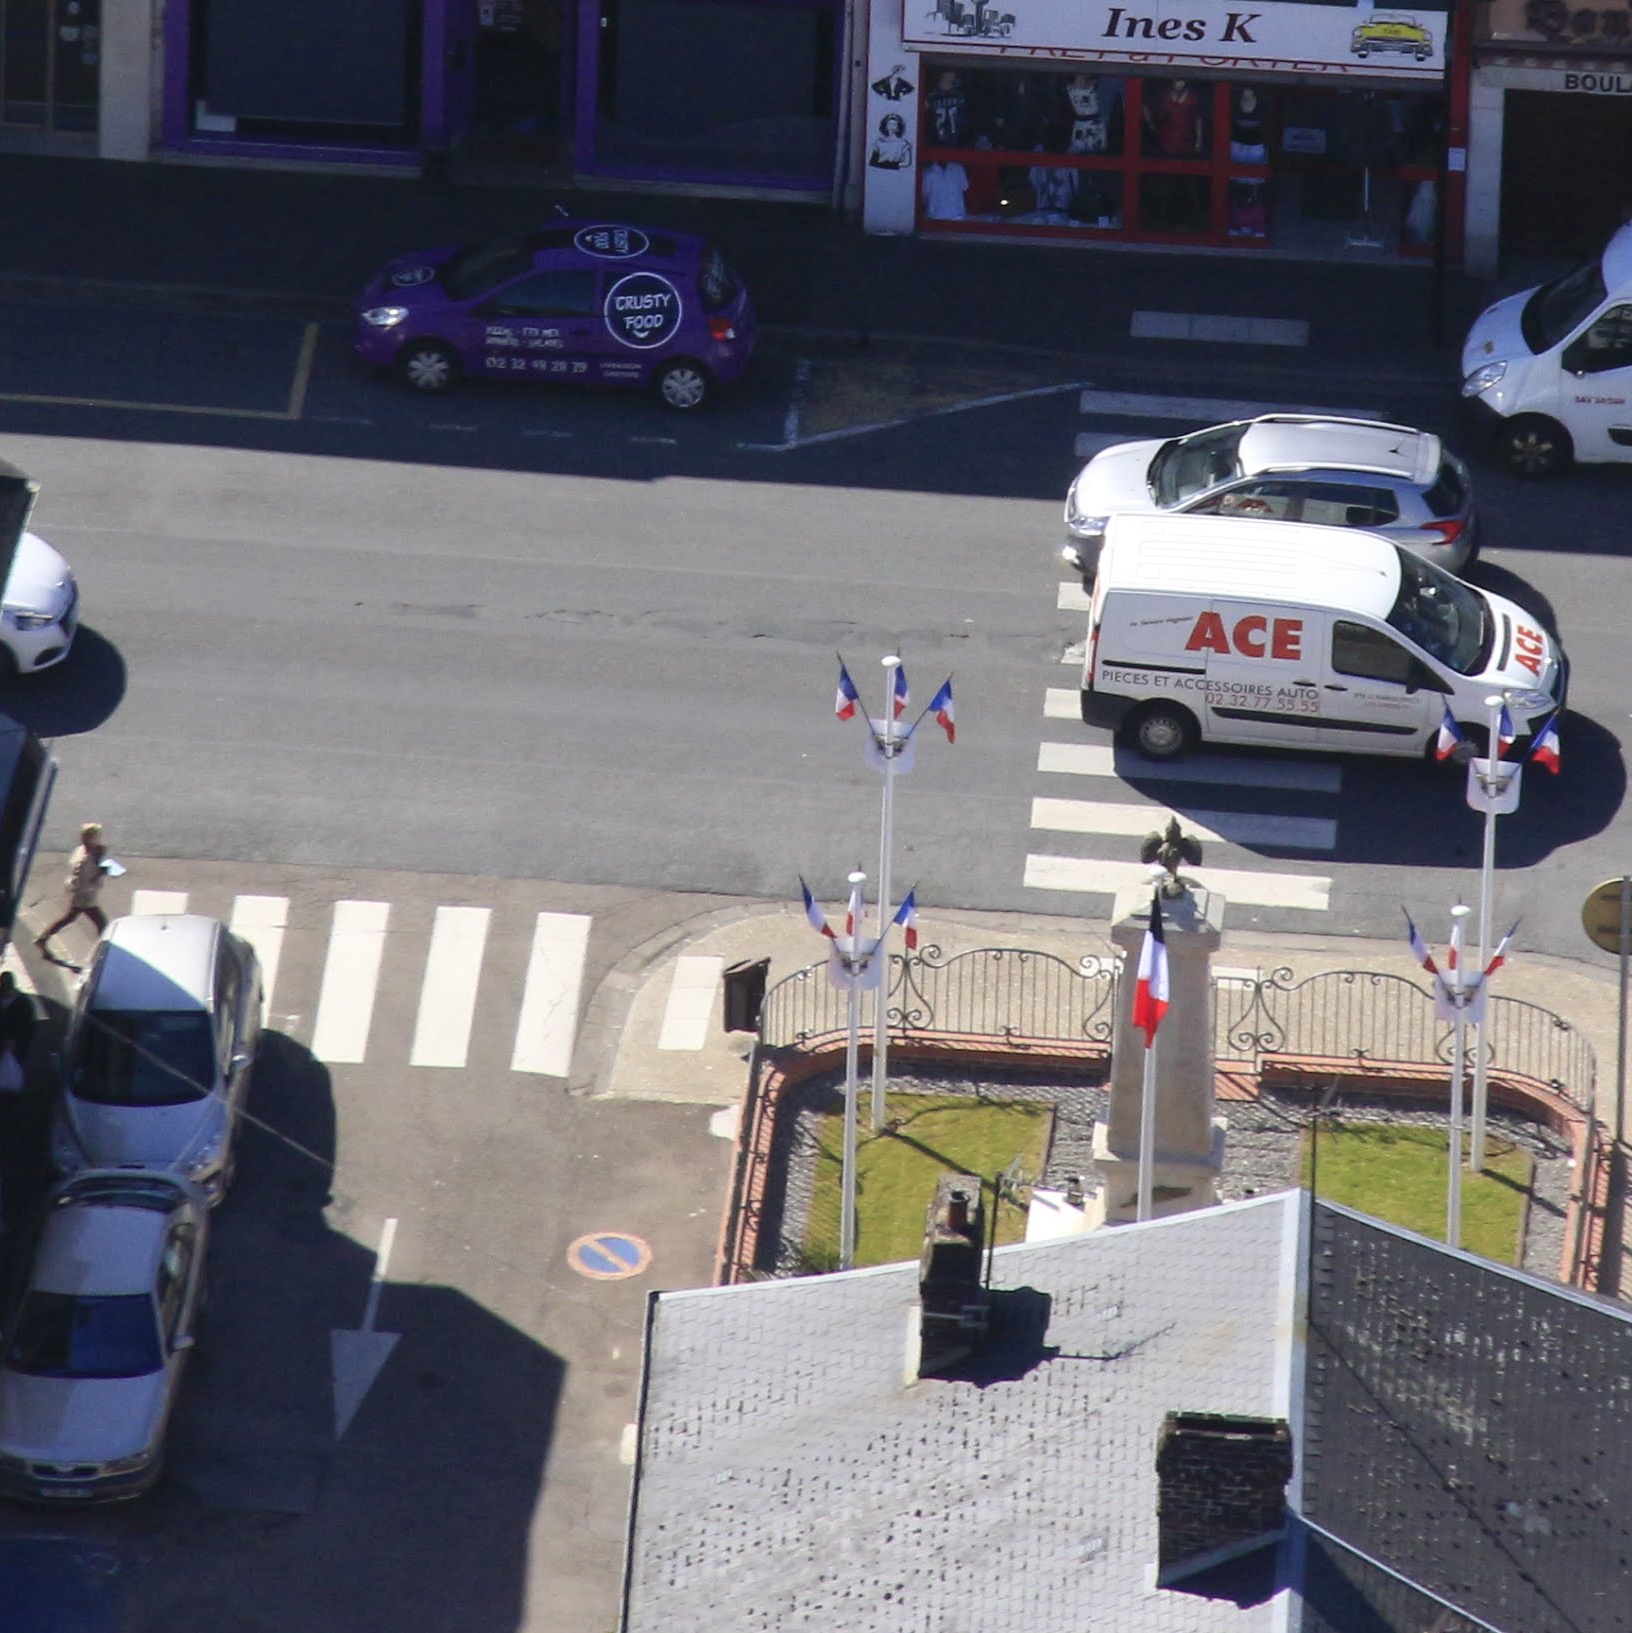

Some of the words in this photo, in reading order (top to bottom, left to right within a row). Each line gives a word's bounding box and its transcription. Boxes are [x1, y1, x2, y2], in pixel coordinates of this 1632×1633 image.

[1101, 7, 1207, 42] Ines
[1218, 12, 1262, 44] K
[614, 293, 672, 311] CRUSTY
[622, 313, 664, 329] FOOD
[485, 356, 507, 369] 02
[1185, 611, 1303, 660] ACE
[1515, 625, 1543, 679] ACE
[1102, 670, 1148, 686] PIECES
[1154, 675, 1170, 687] ET
[1174, 678, 1272, 696] ACCESSOIRES
[1277, 687, 1317, 700] AUTO
